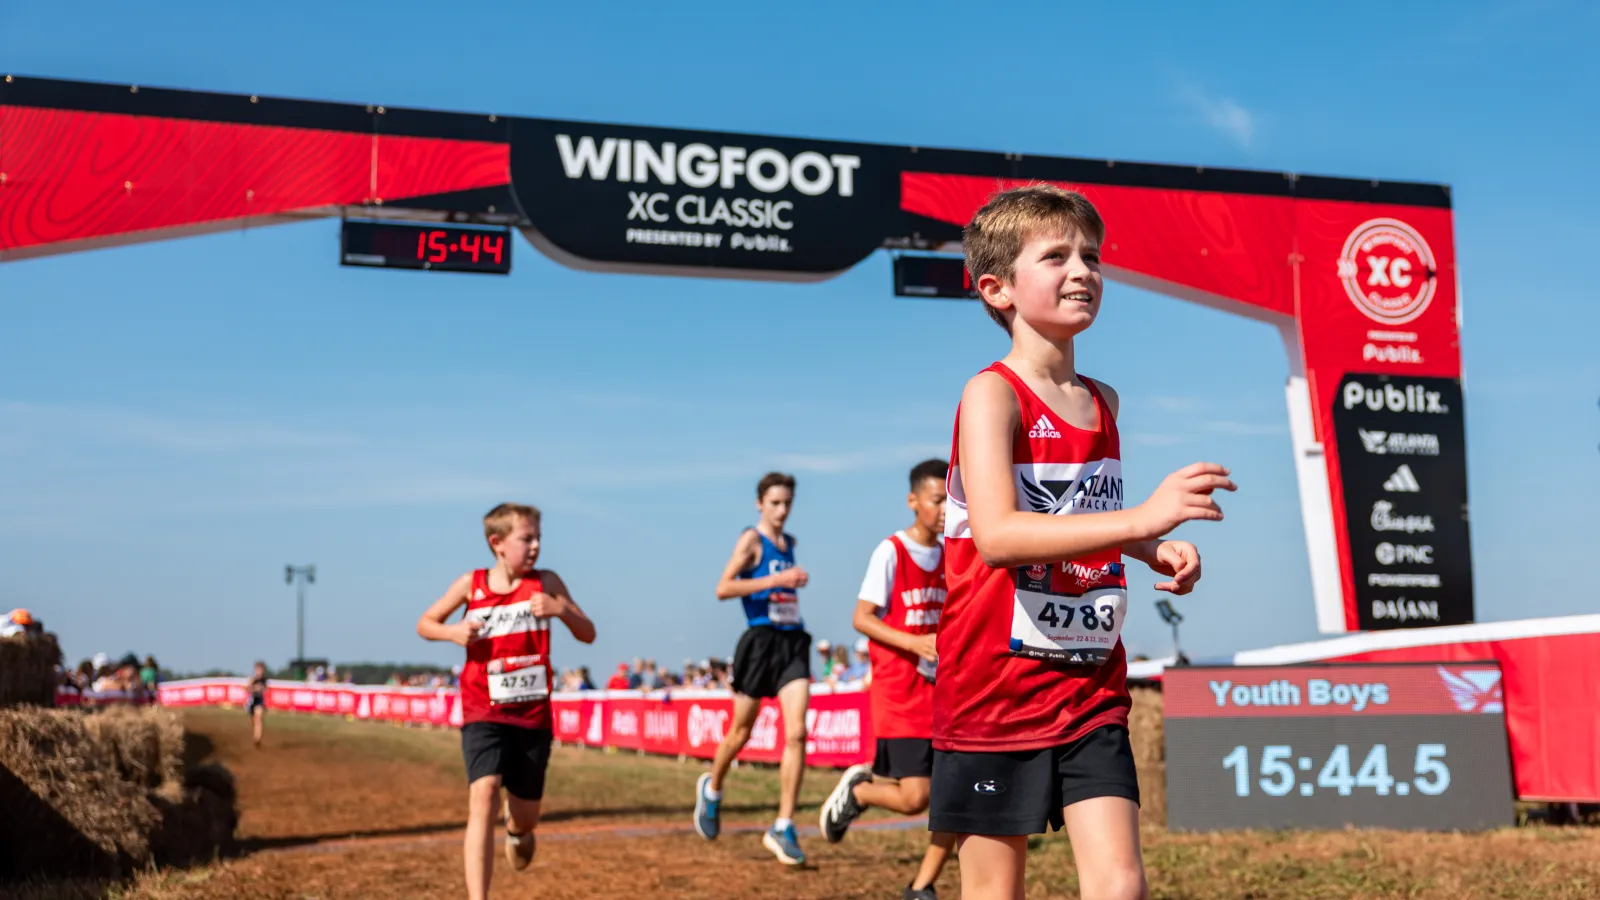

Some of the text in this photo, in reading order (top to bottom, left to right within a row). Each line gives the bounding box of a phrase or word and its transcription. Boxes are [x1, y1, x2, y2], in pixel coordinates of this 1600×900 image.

[555, 134, 861, 197] WINGFOOT
[627, 191, 794, 230] XC CLASSIC
[626, 228, 702, 247] PRESENTED
[703, 232, 723, 248] BY
[1366, 255, 1412, 288] XC
[1028, 429, 1061, 439] adidas
[1072, 498, 1108, 511] TRACK
[1395, 545, 1434, 564] PNC
[1038, 601, 1115, 632] 4783
[1371, 597, 1439, 622] DASANI
[1047, 634, 1074, 642] September
[501, 675, 537, 688] 4757
[1209, 679, 1389, 711] Youth Boys
[1222, 744, 1451, 796] 15:44.5
